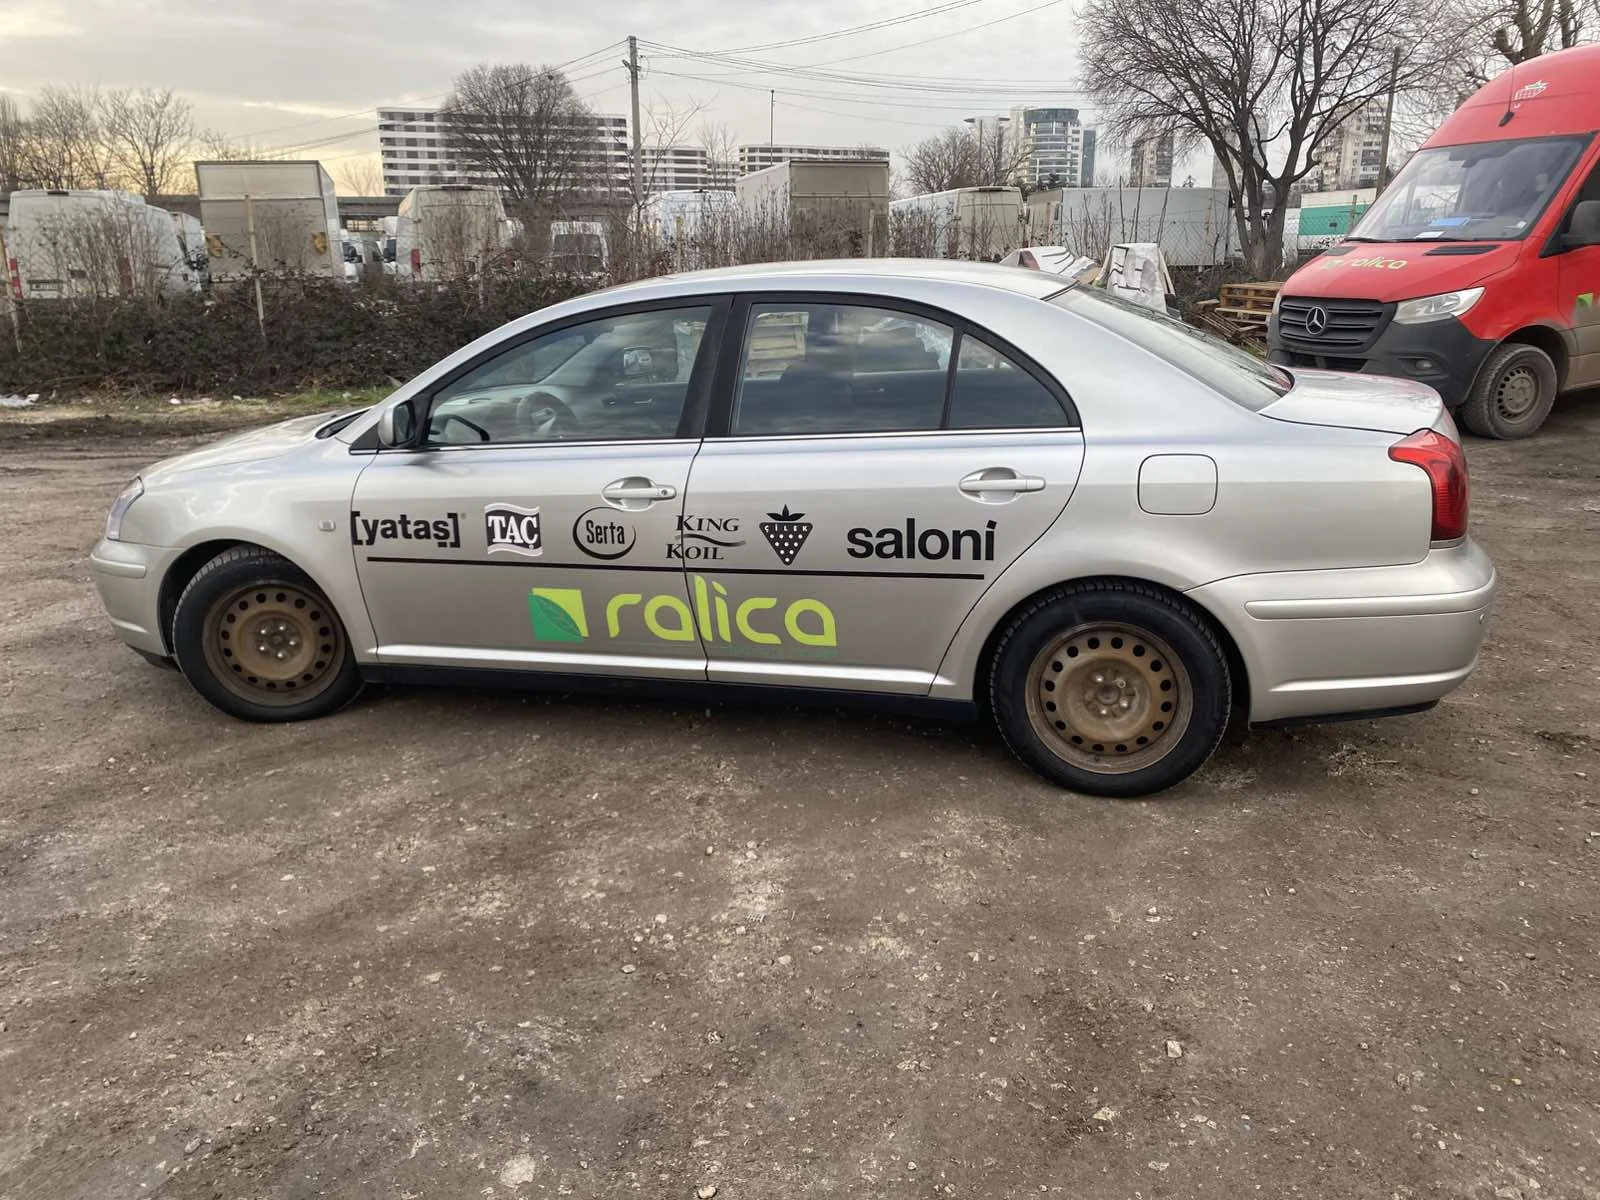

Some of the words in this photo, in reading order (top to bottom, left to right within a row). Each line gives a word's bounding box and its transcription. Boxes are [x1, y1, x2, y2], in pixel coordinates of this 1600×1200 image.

[586, 519, 626, 545] Serta
[675, 515, 740, 532] KING
[666, 543, 725, 560] KOIL
[847, 518, 997, 560] saloni
[606, 575, 838, 647] ralica
